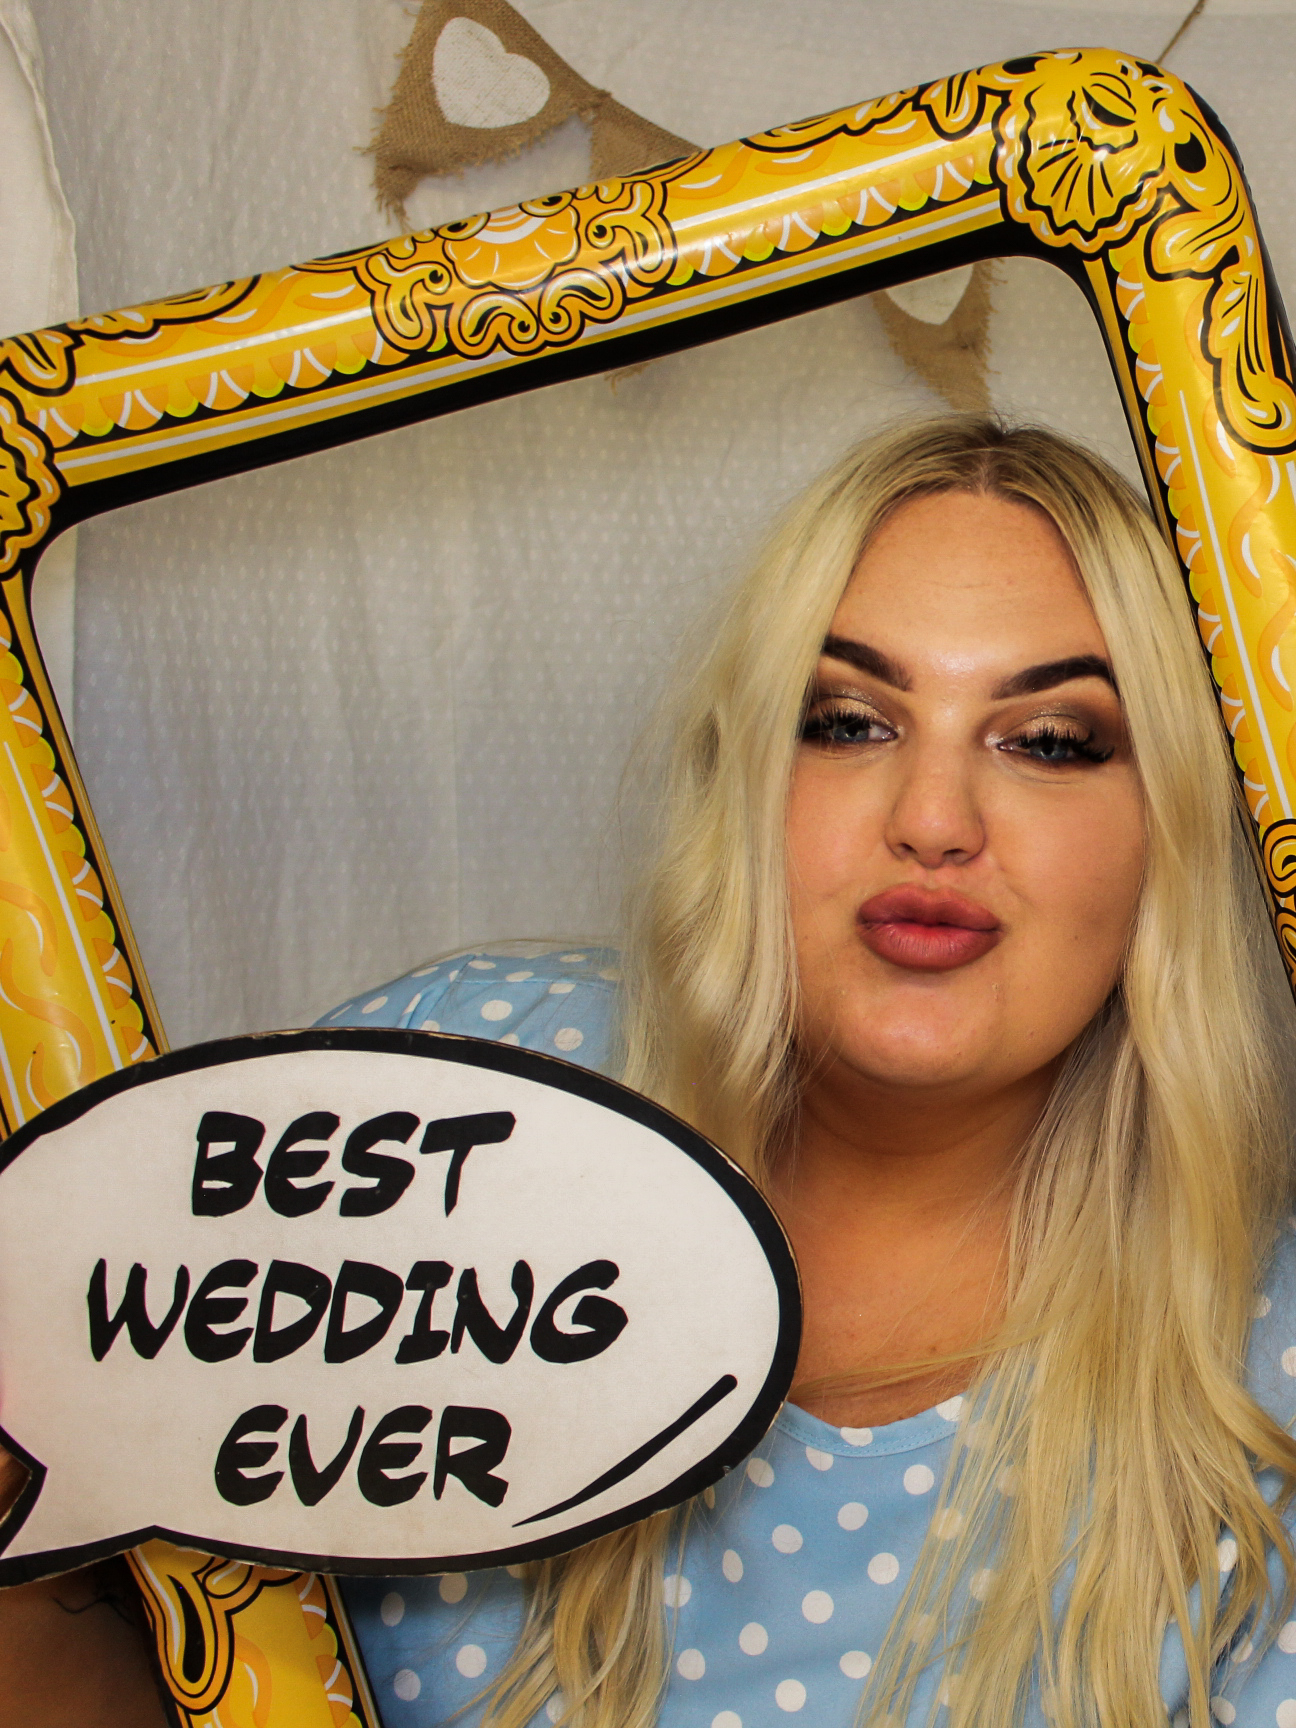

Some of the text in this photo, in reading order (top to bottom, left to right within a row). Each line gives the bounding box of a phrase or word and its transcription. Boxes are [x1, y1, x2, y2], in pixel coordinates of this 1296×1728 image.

[191, 1111, 516, 1217] BEST
[87, 1258, 629, 1364] WEDDING
[214, 1404, 512, 1507] EVER
